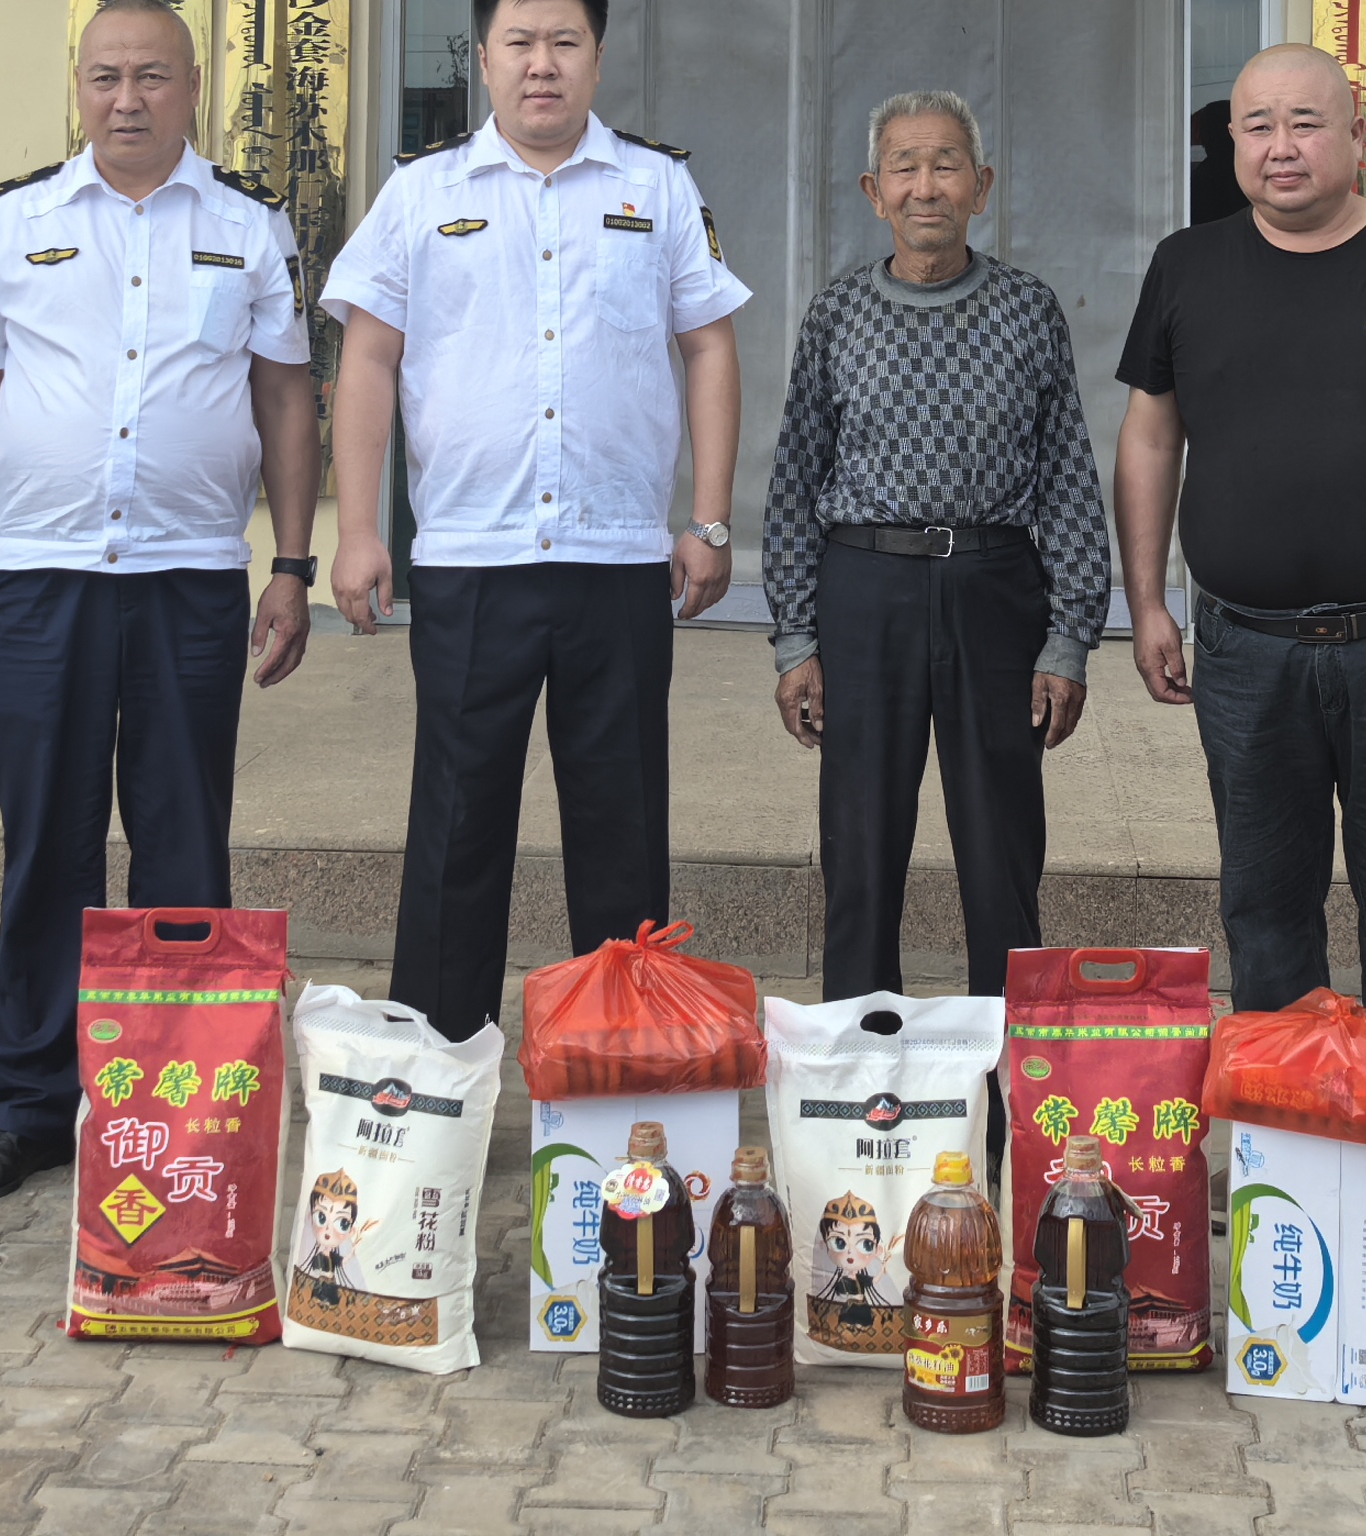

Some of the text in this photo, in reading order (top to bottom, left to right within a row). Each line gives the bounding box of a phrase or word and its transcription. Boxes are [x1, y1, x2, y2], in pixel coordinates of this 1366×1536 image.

[95, 1057, 261, 1107] 常馨牌
[185, 1117, 242, 1134] 长粒香
[1033, 1094, 1200, 1146] 常馨牌
[1128, 1155, 1186, 1174] 长粒香
[107, 1188, 159, 1227] 香
[573, 1180, 602, 1265] 纯牛奶
[1273, 1223, 1303, 1309] 纯牛奶
